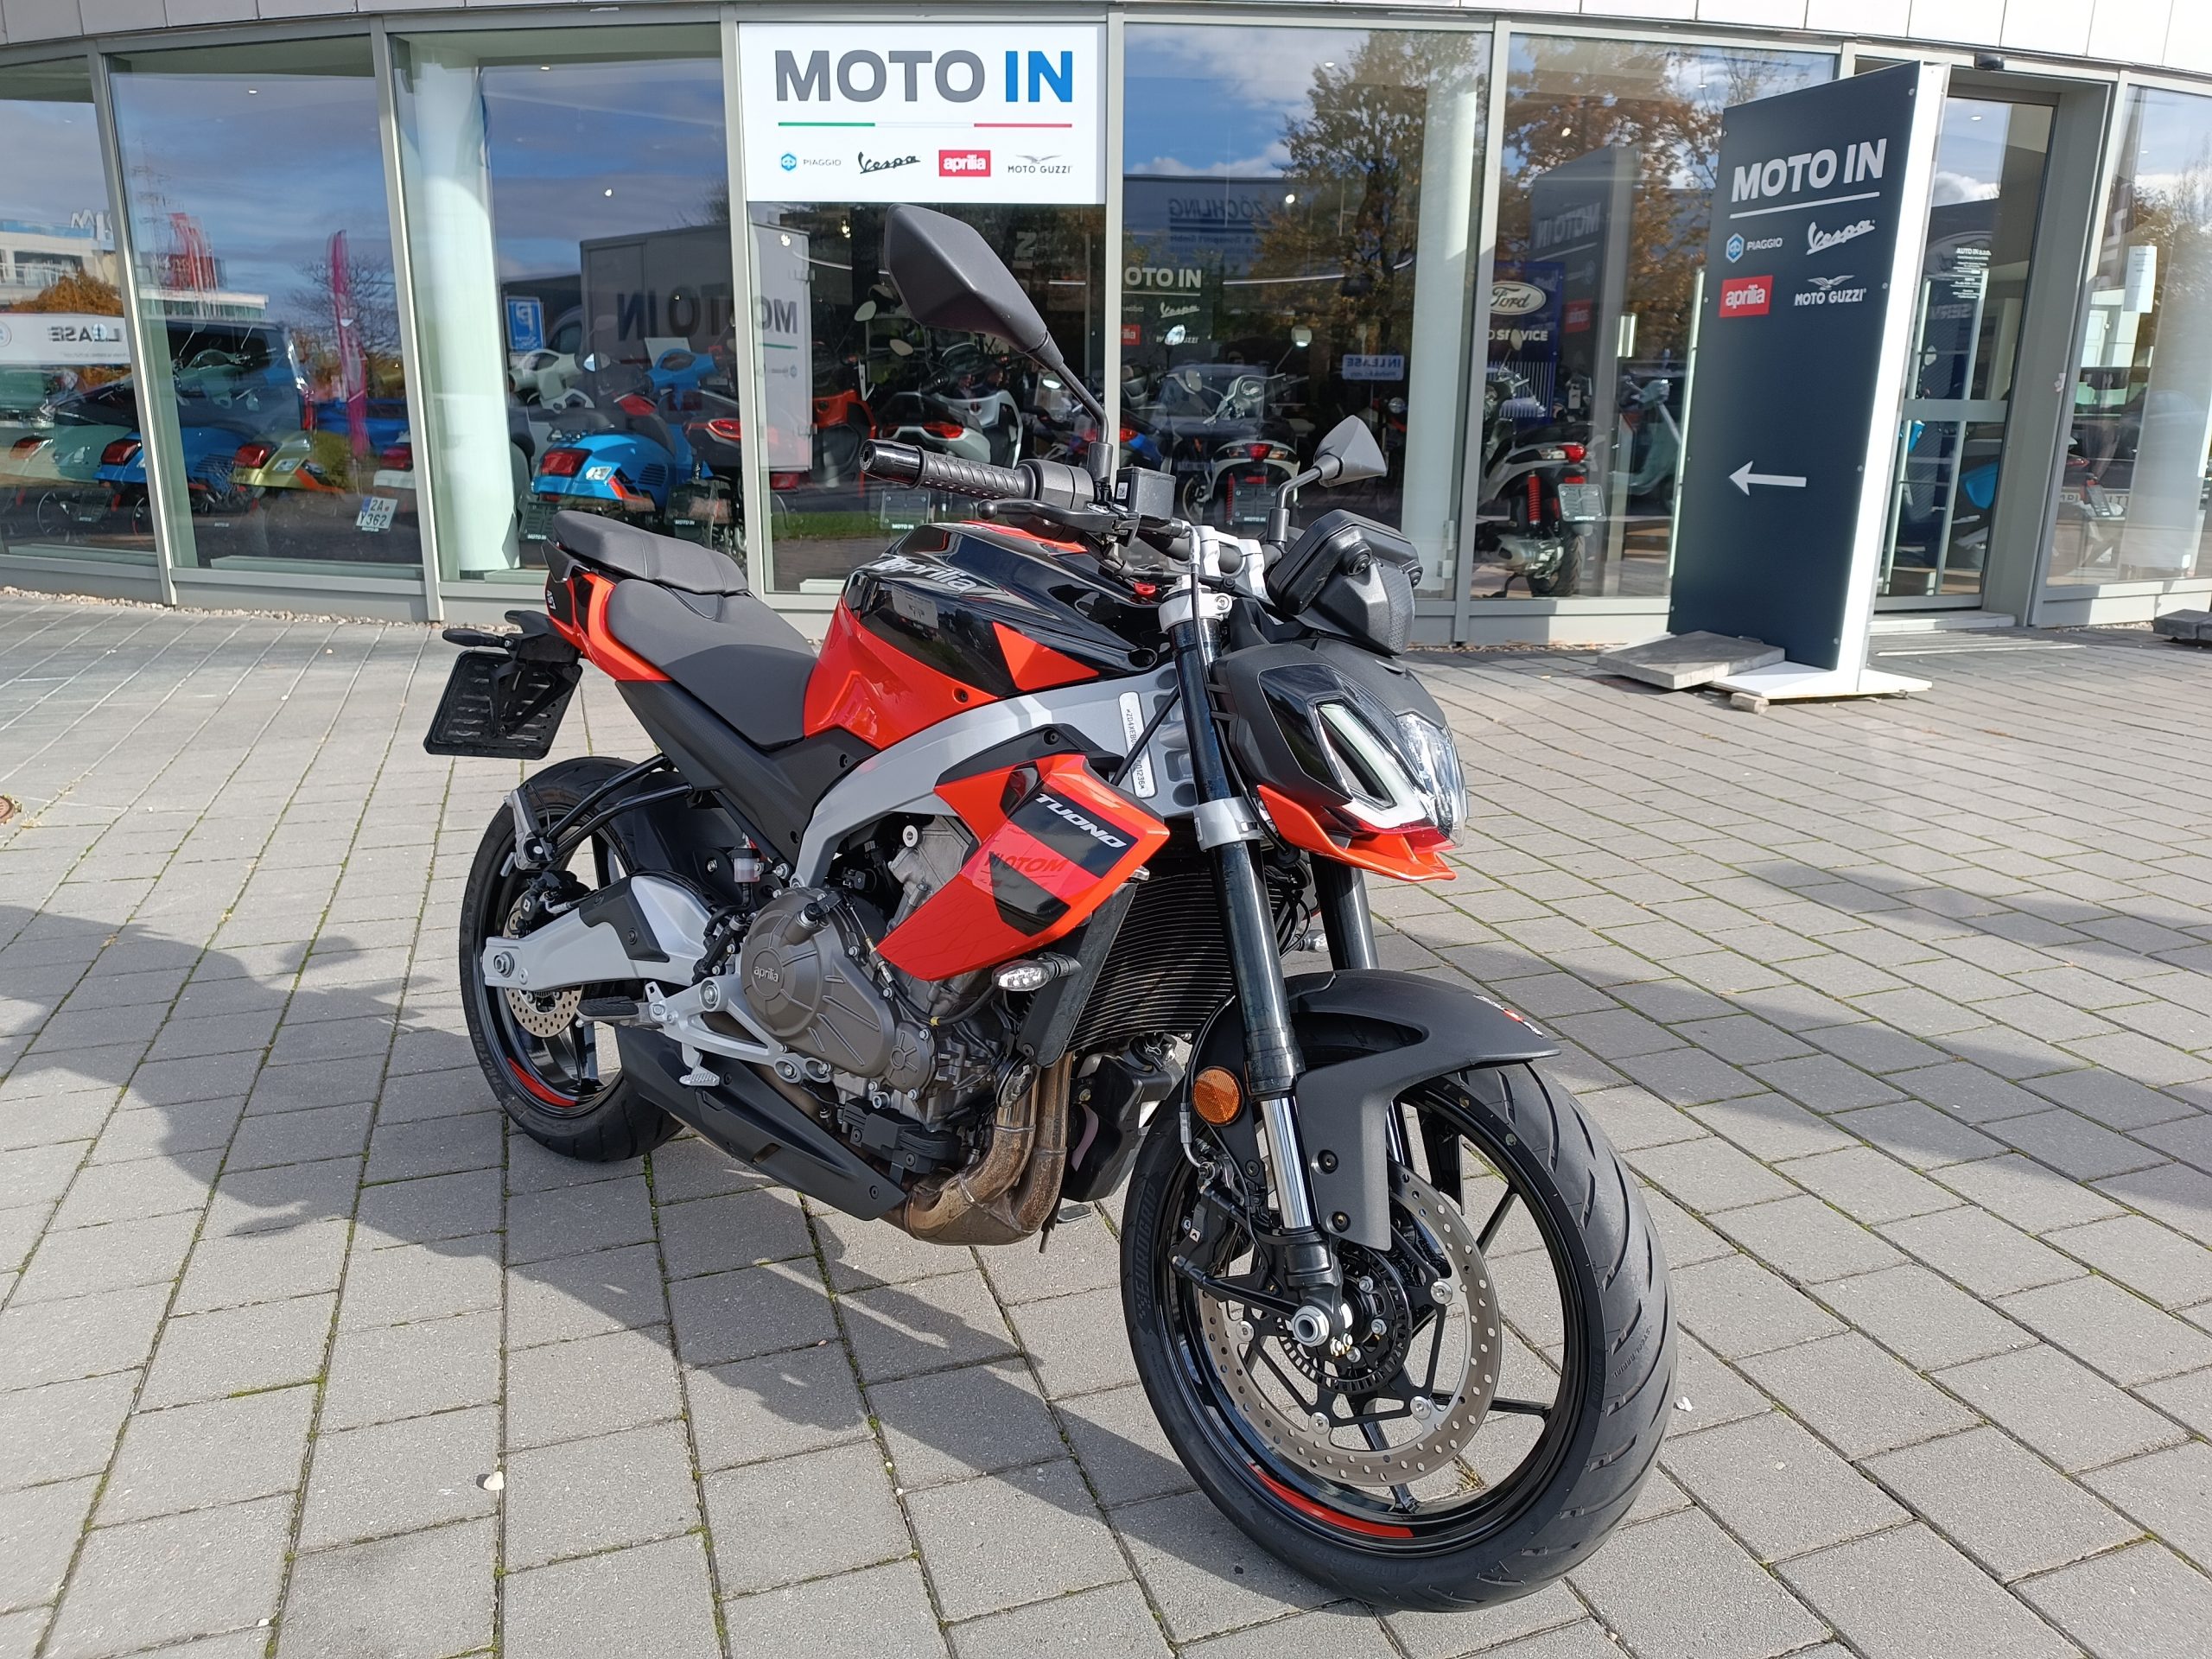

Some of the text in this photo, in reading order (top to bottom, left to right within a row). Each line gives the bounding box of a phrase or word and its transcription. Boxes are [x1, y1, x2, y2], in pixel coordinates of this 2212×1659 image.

[774, 49, 1072, 103] MOTO IN
[858, 151, 921, 175] Vespa
[943, 155, 986, 174] aprilia
[1007, 165, 1071, 174] MOTO GUZZI
[1731, 138, 1887, 202] MOTO IN
[1746, 237, 1783, 251] PIAGGIO
[1806, 219, 1875, 255] Vespa
[1124, 267, 1202, 288] OTO IN
[1491, 286, 1531, 308] Ford
[1725, 283, 1765, 308] aprilia
[1794, 289, 1863, 307] MOTO GUZZI
[1498, 329, 1548, 341] SEVICE
[1035, 793, 1127, 849] TUONO
[753, 966, 779, 982] aprilia
[1135, 1182, 1159, 1295] EUROGRIP
